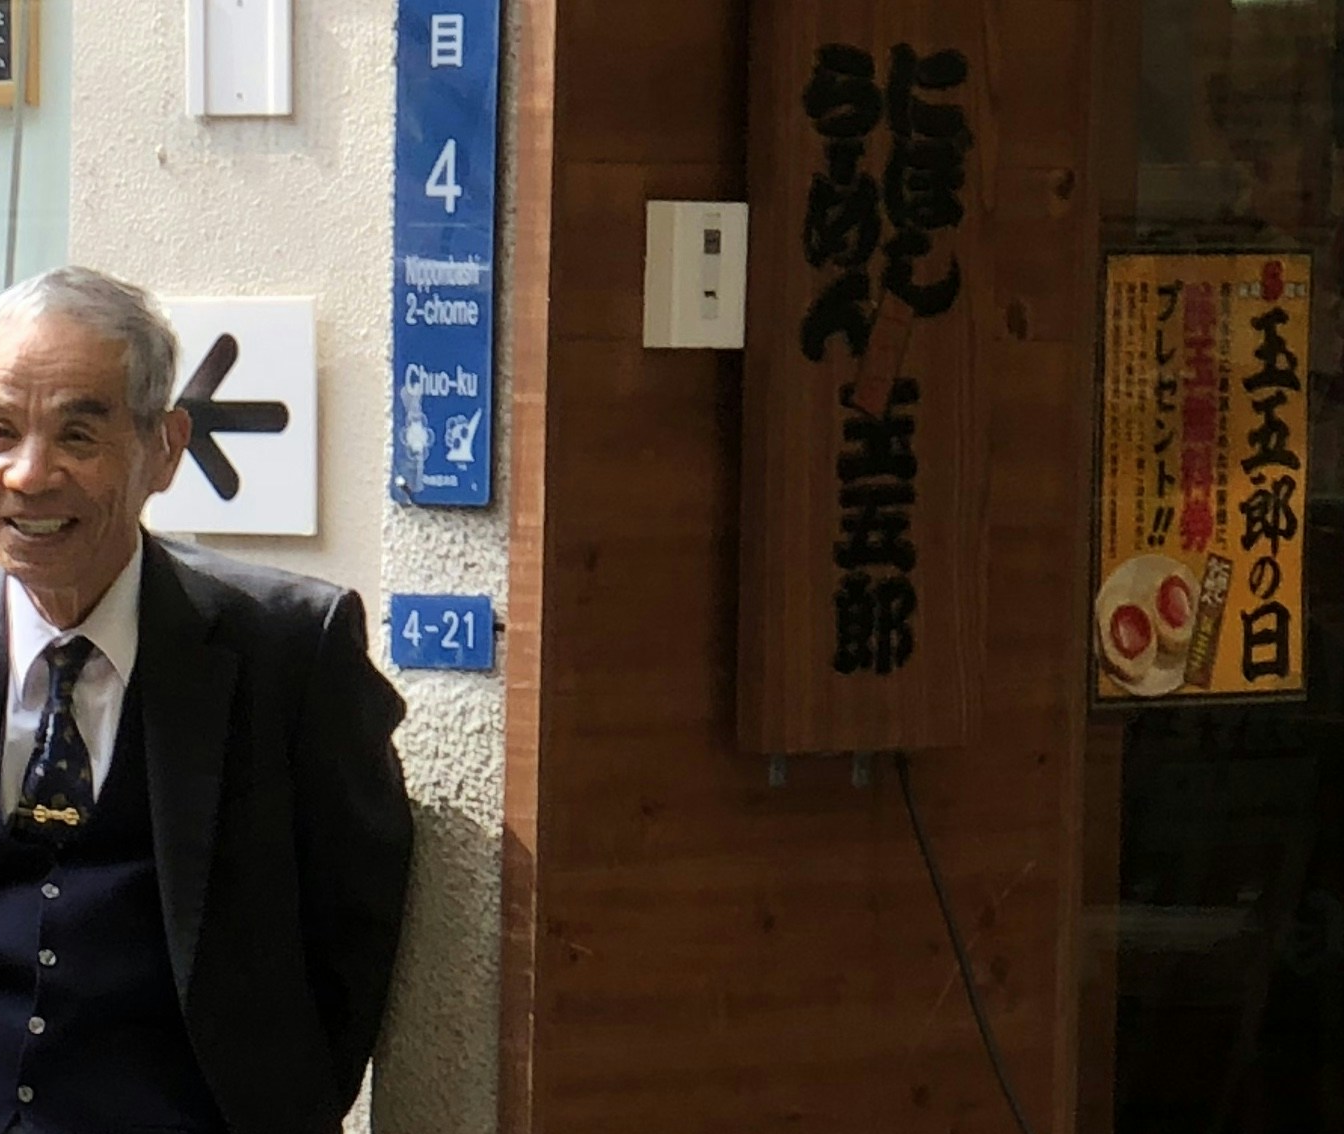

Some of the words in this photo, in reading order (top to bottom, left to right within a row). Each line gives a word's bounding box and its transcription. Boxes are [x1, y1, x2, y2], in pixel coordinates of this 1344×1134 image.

[431, 13, 463, 68] 目
[425, 138, 462, 214] 4
[801, 42, 882, 362] らーめん
[405, 292, 480, 326] 2-chome
[405, 363, 478, 397] Chuo-ku
[1239, 306, 1302, 683] 玉五郎の日
[402, 609, 474, 649] 4-21
